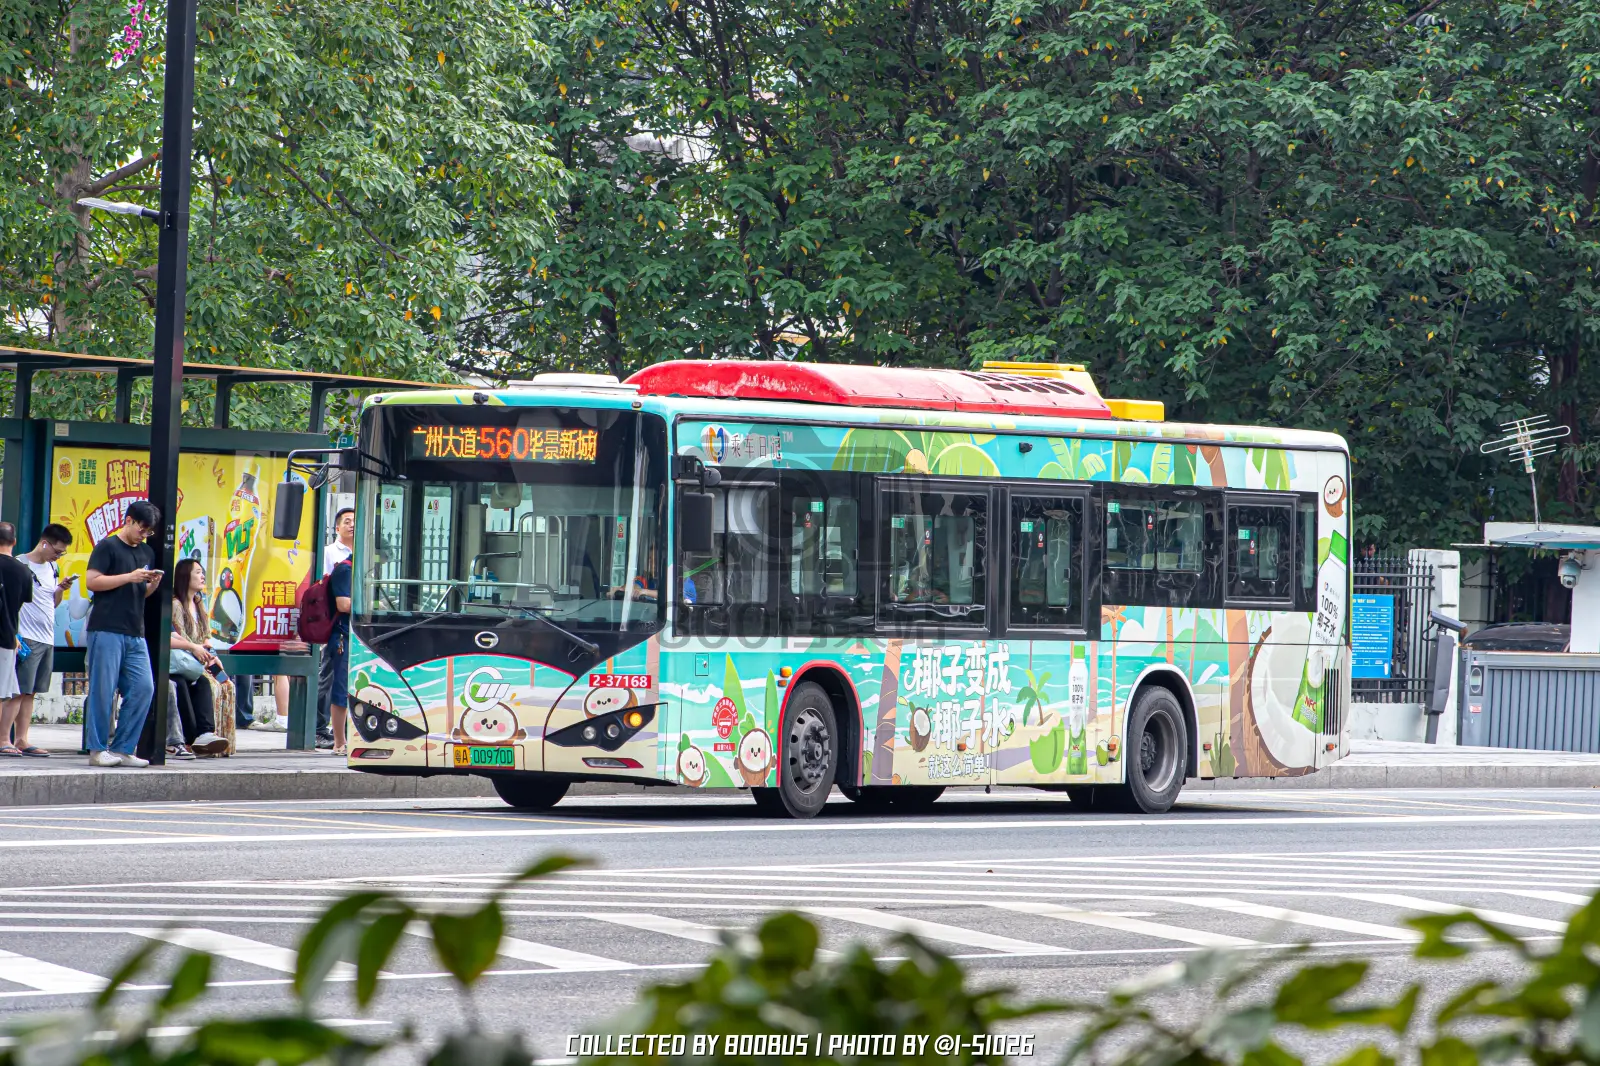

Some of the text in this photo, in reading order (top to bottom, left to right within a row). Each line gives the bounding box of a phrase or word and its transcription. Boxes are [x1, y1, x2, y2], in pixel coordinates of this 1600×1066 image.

[479, 427, 529, 459] 560
[529, 428, 598, 460] 华景新城
[592, 675, 648, 687] 2-37168
[903, 641, 1011, 698] 椰子变成
[932, 697, 1009, 751] 椰子水
